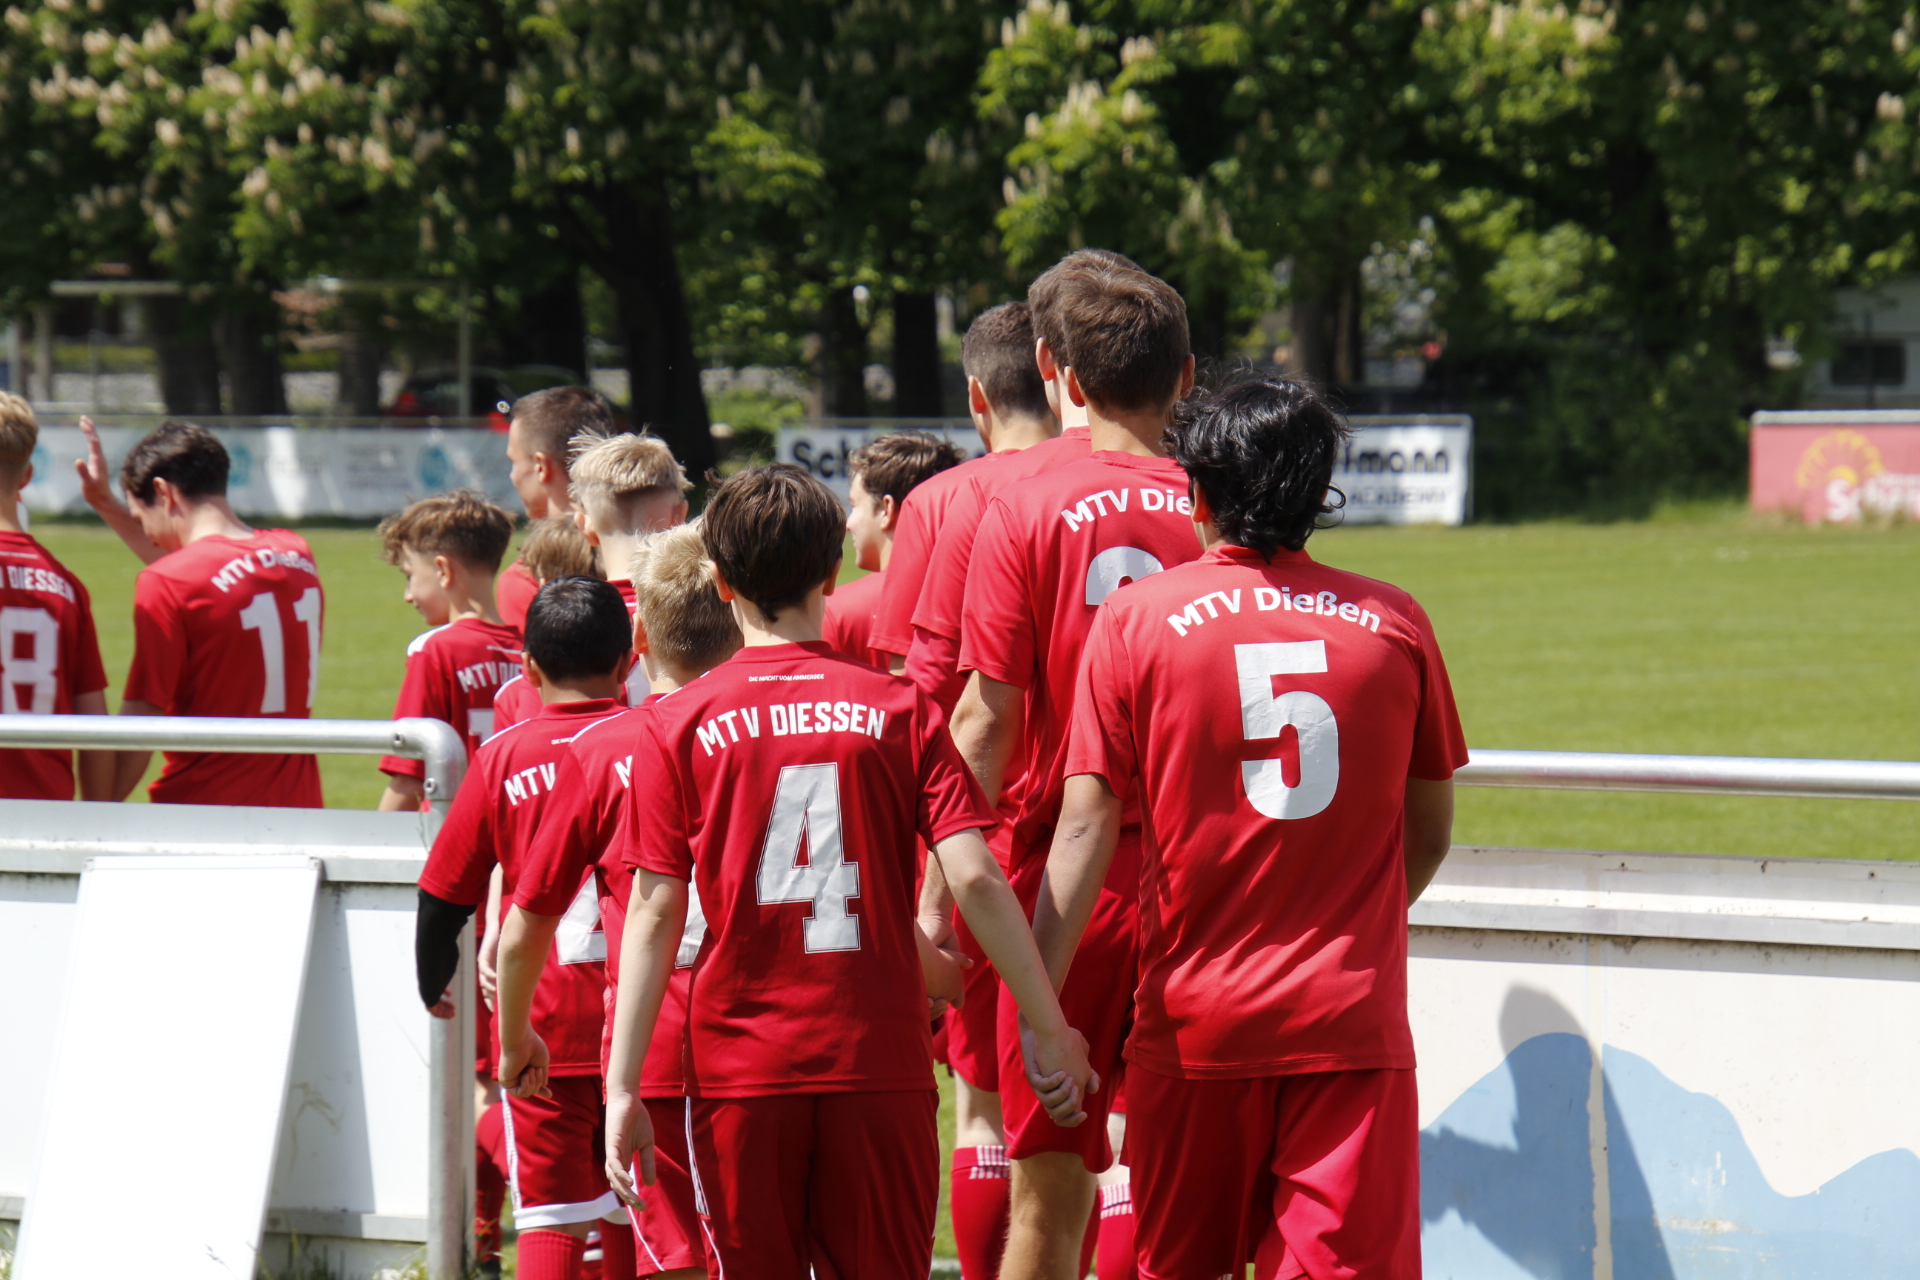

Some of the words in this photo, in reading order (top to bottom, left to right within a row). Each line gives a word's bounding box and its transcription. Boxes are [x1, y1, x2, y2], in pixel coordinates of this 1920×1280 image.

[1061, 488, 1128, 532] MTV
[7, 566, 75, 604] DIESSEN
[211, 554, 256, 593] MTV
[1167, 589, 1241, 637] MTV
[1254, 586, 1381, 633] Dießen
[239, 586, 321, 714] 11
[457, 662, 498, 693] MTV
[696, 706, 760, 757] MTV
[769, 701, 886, 741] DIESSEN
[1234, 640, 1340, 820] 5
[503, 762, 556, 806] MTV
[755, 762, 861, 954] 4
